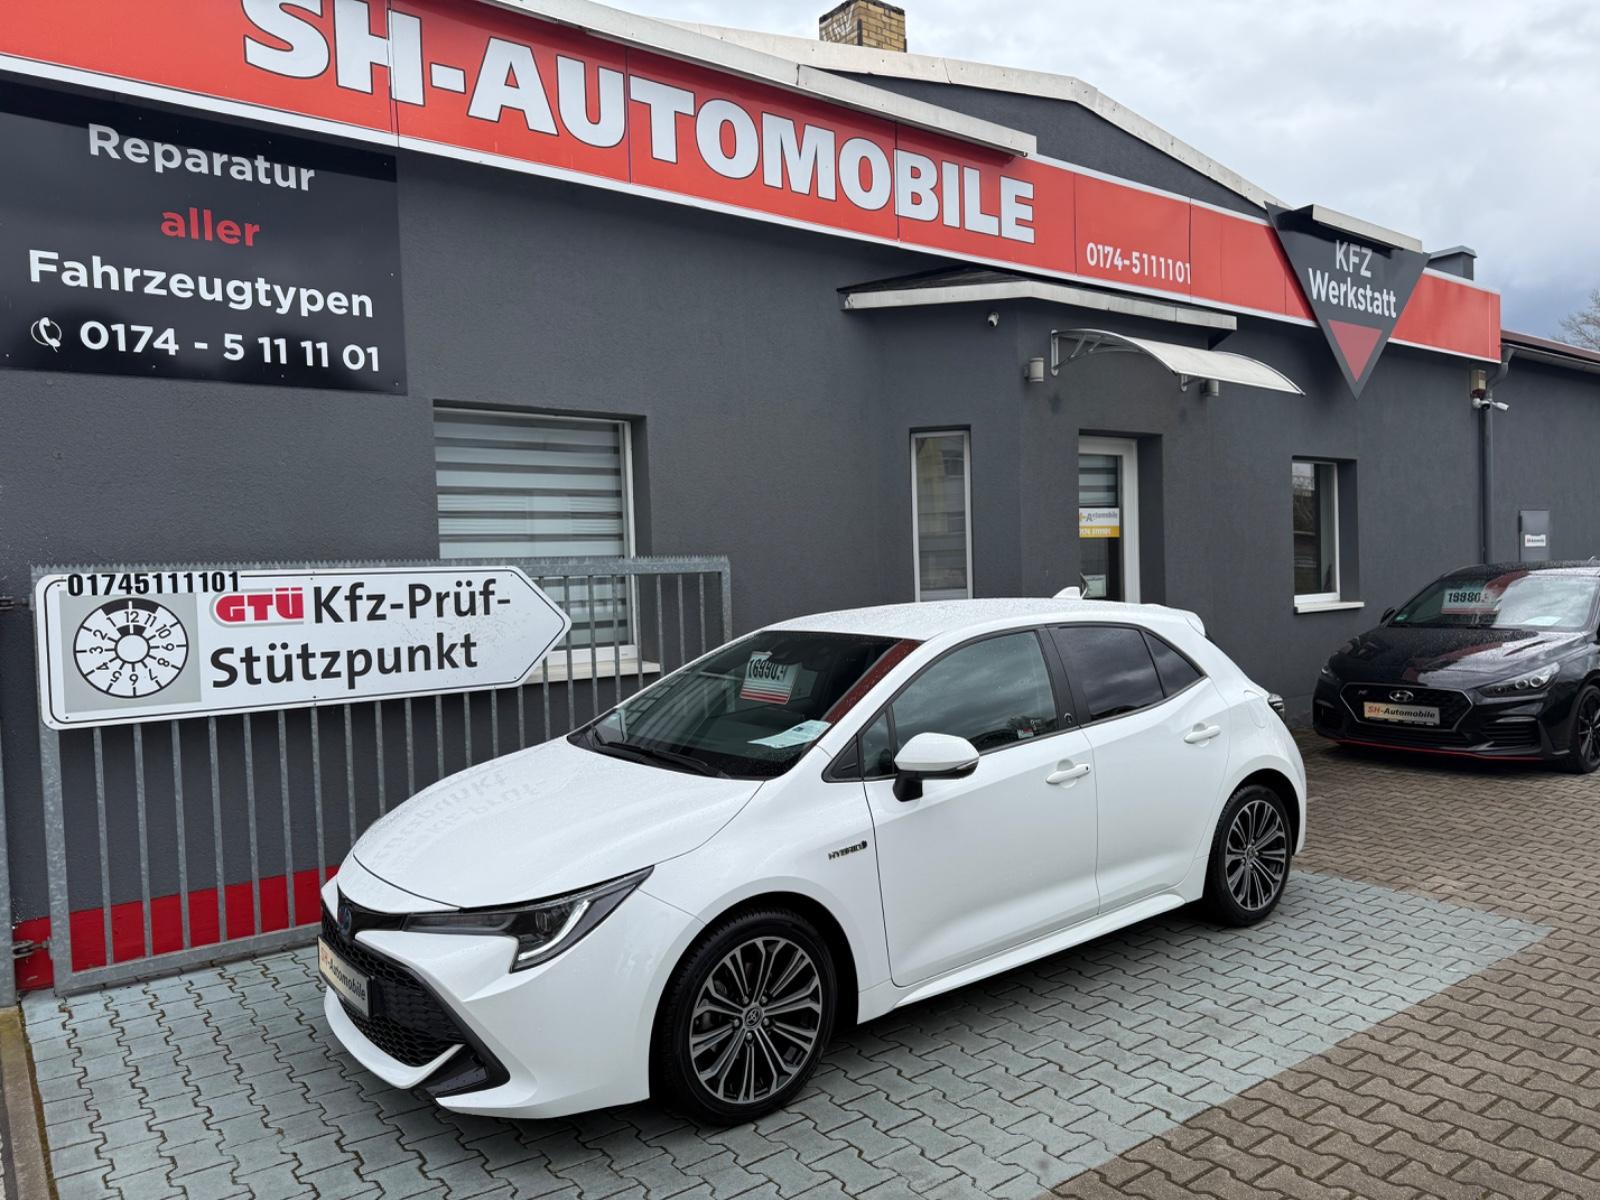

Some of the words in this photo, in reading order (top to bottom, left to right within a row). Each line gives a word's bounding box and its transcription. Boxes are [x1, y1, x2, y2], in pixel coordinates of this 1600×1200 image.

[243, 0, 1036, 244] SH-AUTOMOBILE
[88, 123, 316, 192] Reparatur
[160, 207, 261, 247] aller
[1086, 242, 1191, 285] 0174-5111101
[1335, 240, 1372, 278] KFZ
[29, 249, 374, 318] Fahrzeugtypen
[1308, 267, 1397, 319] Werkstatt
[80, 320, 180, 356] 0174
[223, 332, 245, 361] 5
[257, 336, 287, 365] 11
[300, 340, 329, 368] 11
[342, 344, 380, 372] 01
[67, 572, 239, 597] 01745111101
[216, 588, 305, 623] GTÜ
[313, 579, 511, 624] Kfz-Prüf-
[106, 617, 117, 627] 1
[124, 611, 139, 623] 12
[144, 613, 157, 627] 11
[93, 629, 108, 640] 2
[155, 623, 172, 639] 10
[89, 646, 103, 654] 3
[161, 643, 175, 651] 9
[95, 662, 110, 671] 4
[157, 657, 170, 667] 8
[211, 633, 478, 689] Stützpunkt
[110, 670, 122, 683] 5
[129, 673, 139, 686] 6
[148, 668, 158, 681] 7
[1367, 705, 1436, 719] SH-Automobile
[827, 843, 863, 860] HYBRID
